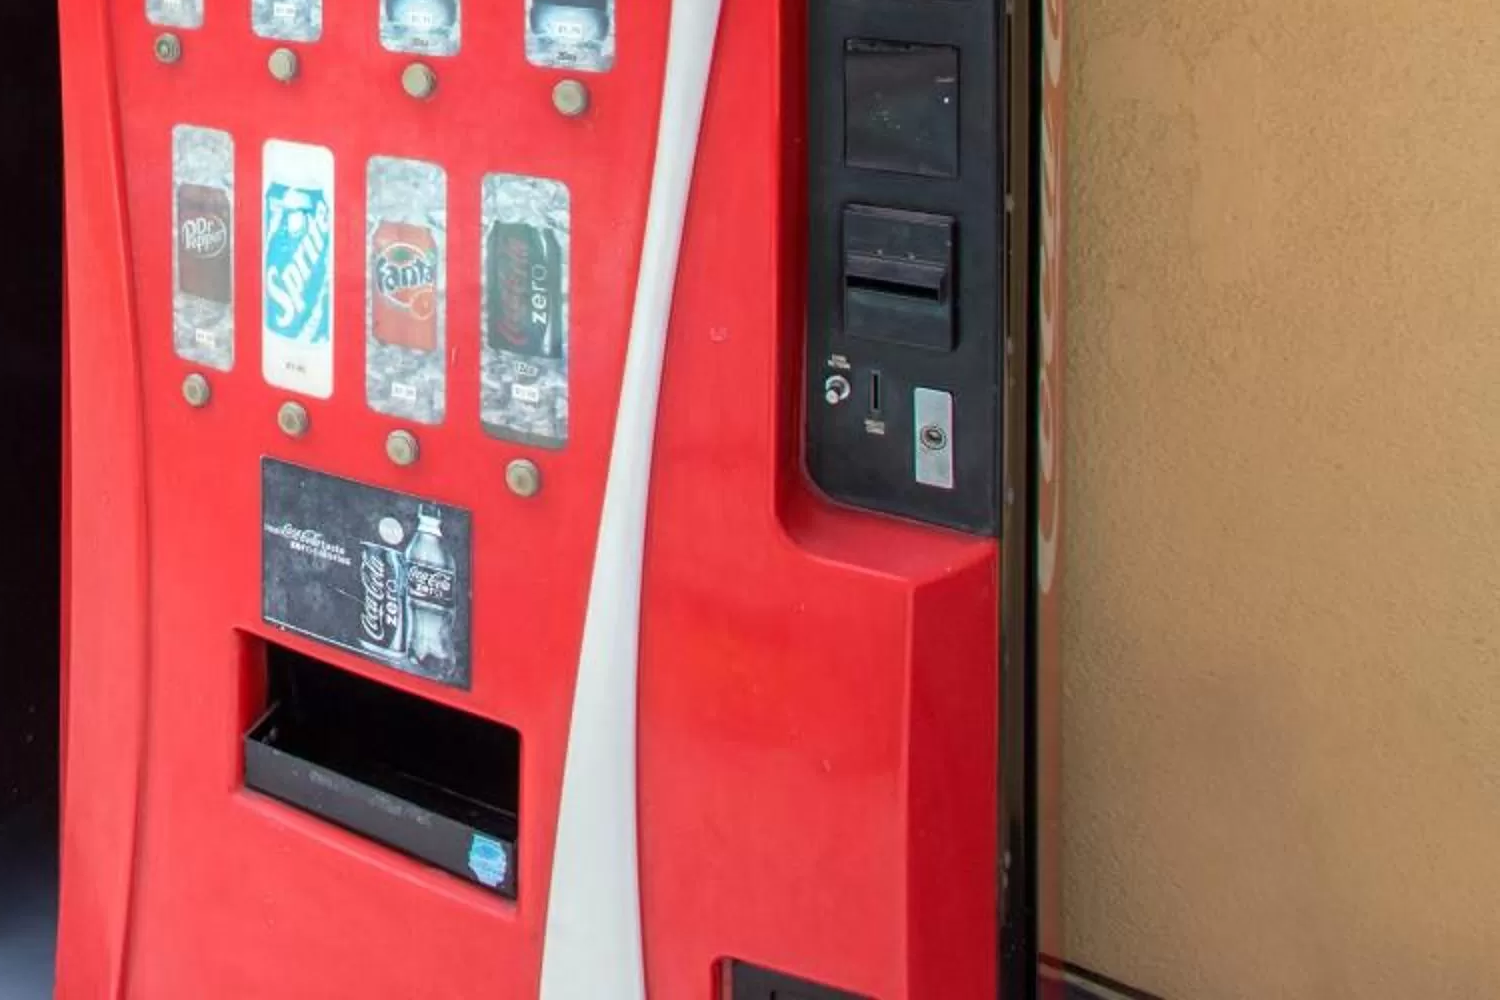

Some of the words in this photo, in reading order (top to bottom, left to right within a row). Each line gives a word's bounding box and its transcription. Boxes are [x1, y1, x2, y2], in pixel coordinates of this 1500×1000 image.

[267, 200, 329, 328] Sprite
[376, 255, 436, 295] Fanta
[531, 263, 548, 325] zero
[385, 579, 397, 627] zero
